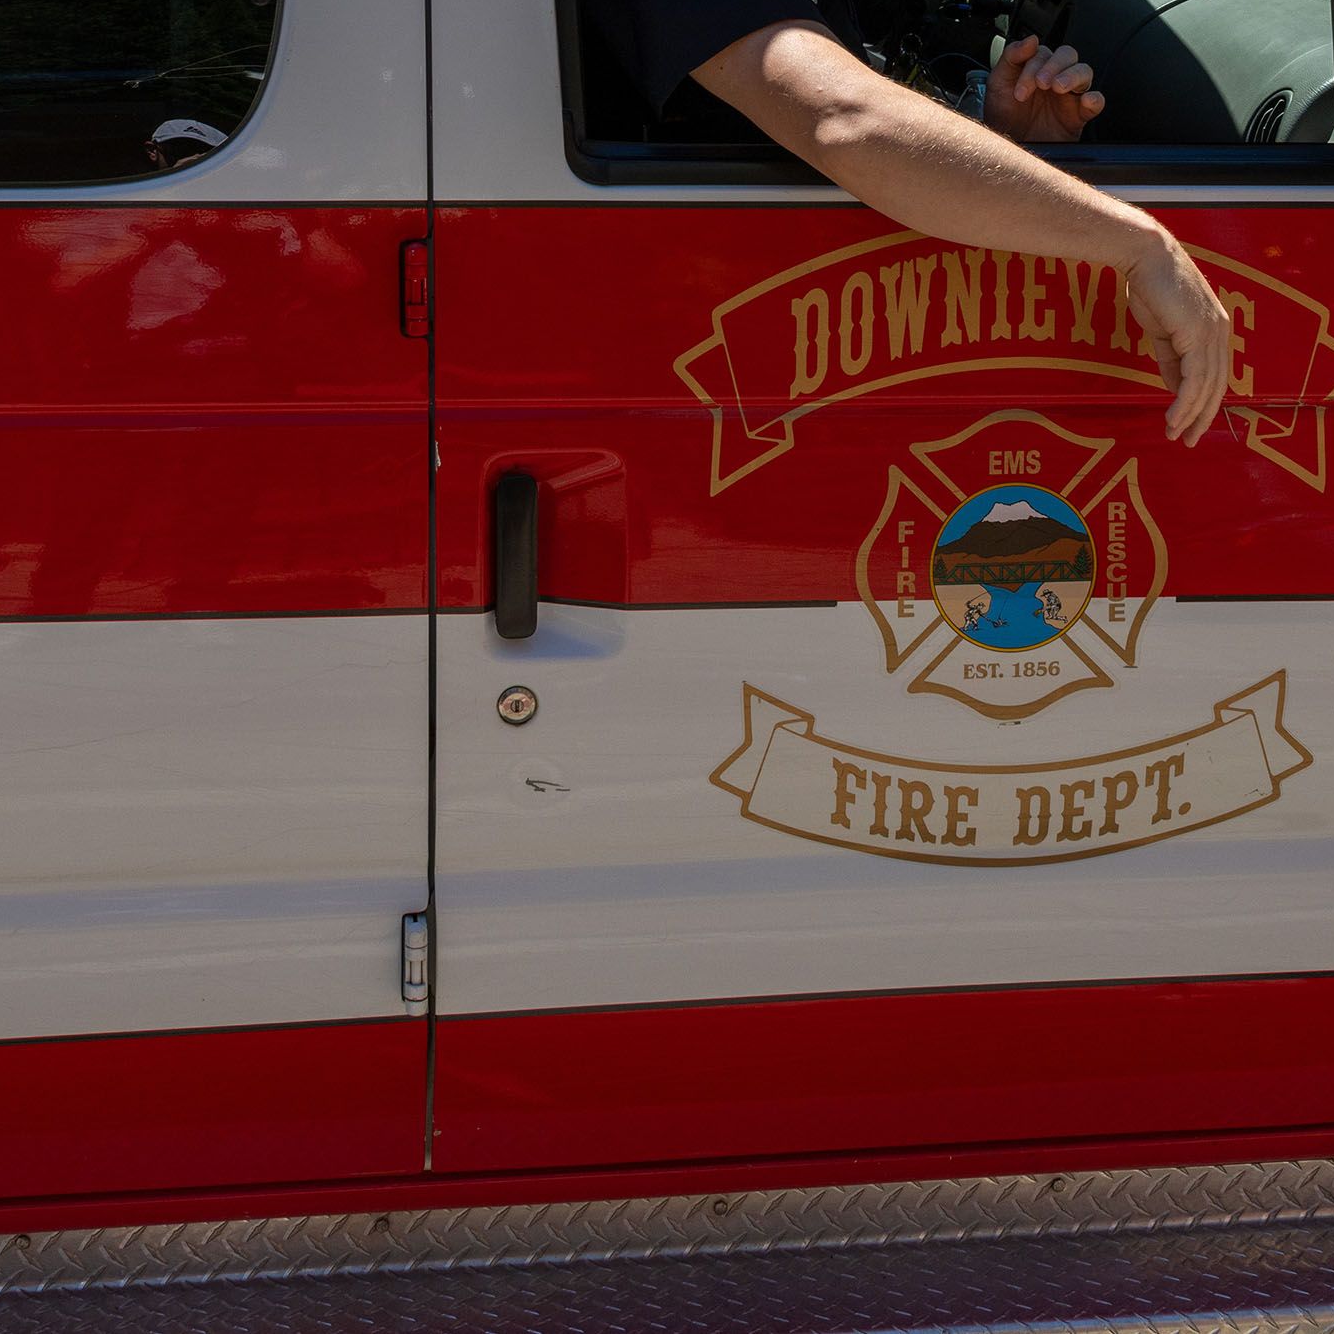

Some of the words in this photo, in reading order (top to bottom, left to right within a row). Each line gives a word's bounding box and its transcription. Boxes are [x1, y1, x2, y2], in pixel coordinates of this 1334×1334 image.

[789, 246, 1255, 398] DOWNIEVIE
[988, 450, 1042, 476] EMS
[896, 520, 916, 618] FIRE
[1105, 501, 1128, 623] RESCUE
[963, 663, 1004, 679] EST.
[1011, 661, 1061, 678] 1856
[830, 756, 979, 846] FIRE
[1012, 751, 1192, 846] DEPT.
